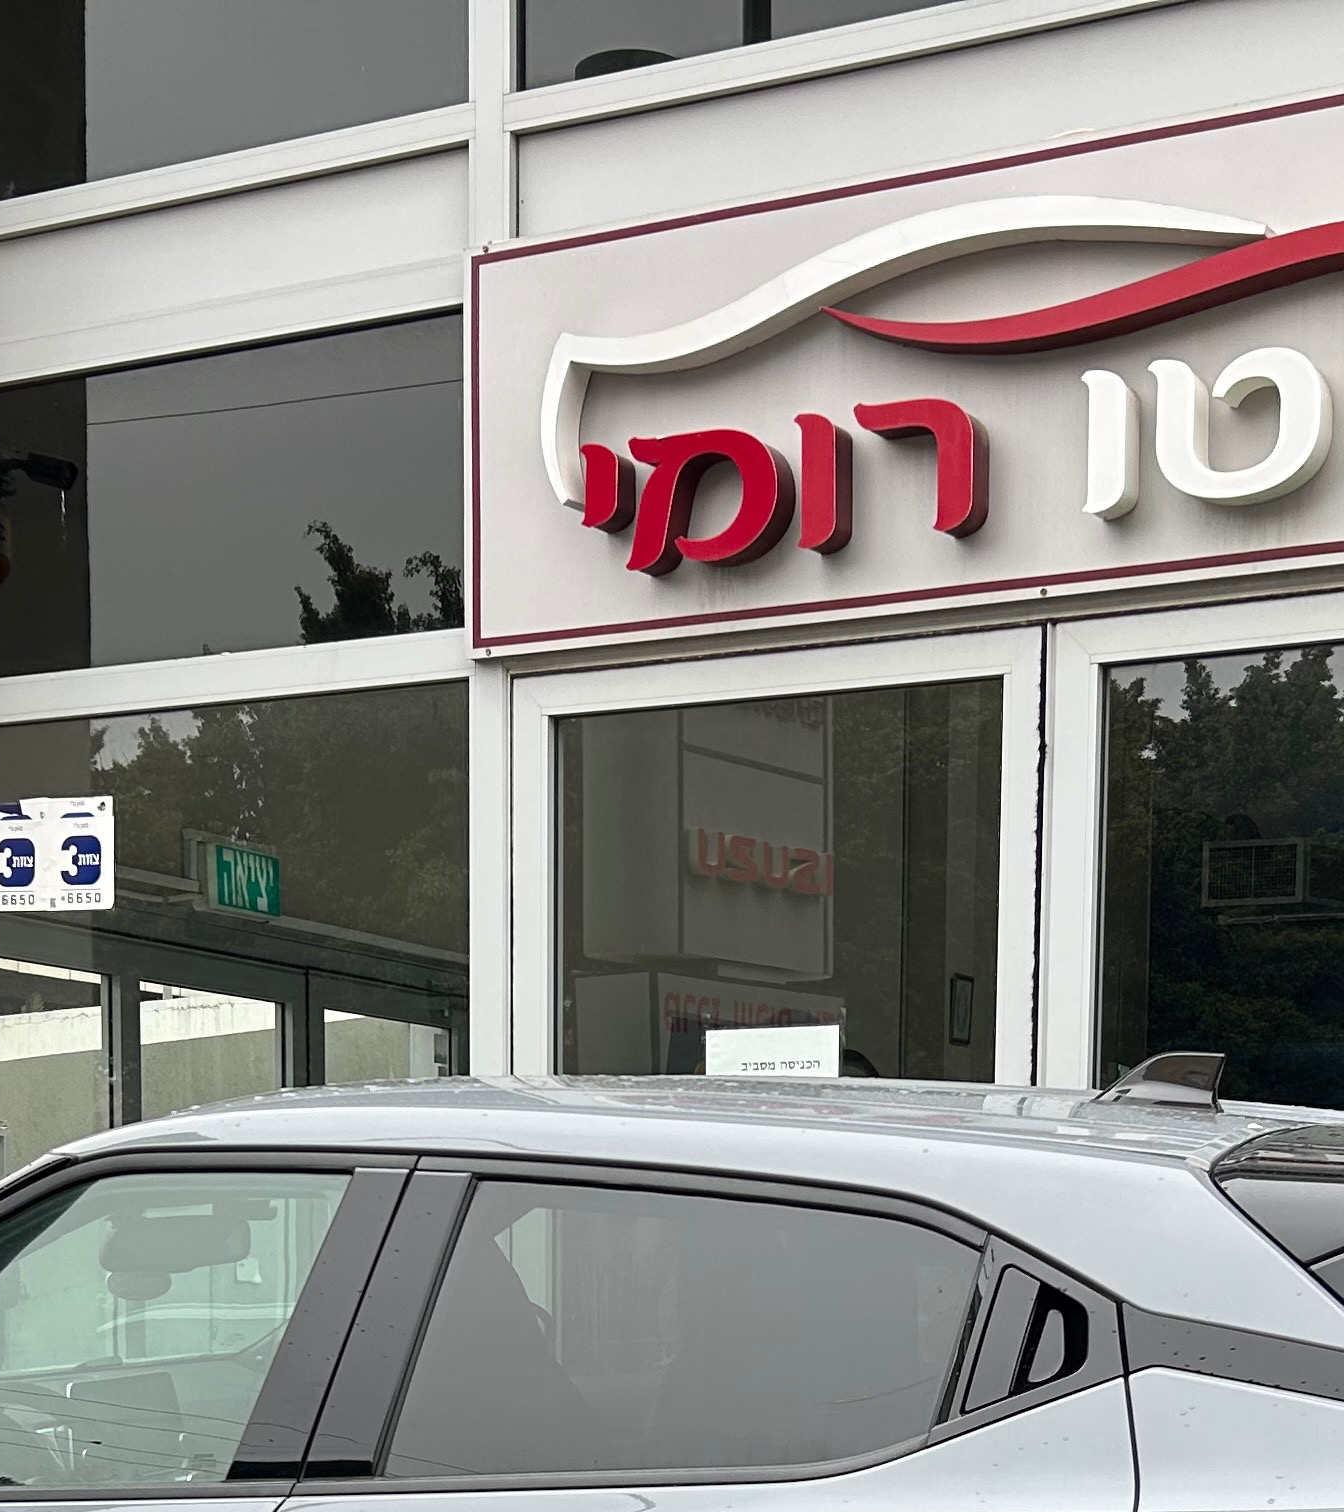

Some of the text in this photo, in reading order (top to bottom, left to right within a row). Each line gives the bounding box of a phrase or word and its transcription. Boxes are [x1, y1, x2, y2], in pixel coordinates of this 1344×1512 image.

[579, 400, 991, 578] רומי
[221, 848, 276, 913] יציאה
[740, 1058, 821, 1072] הכניסה מסביב
